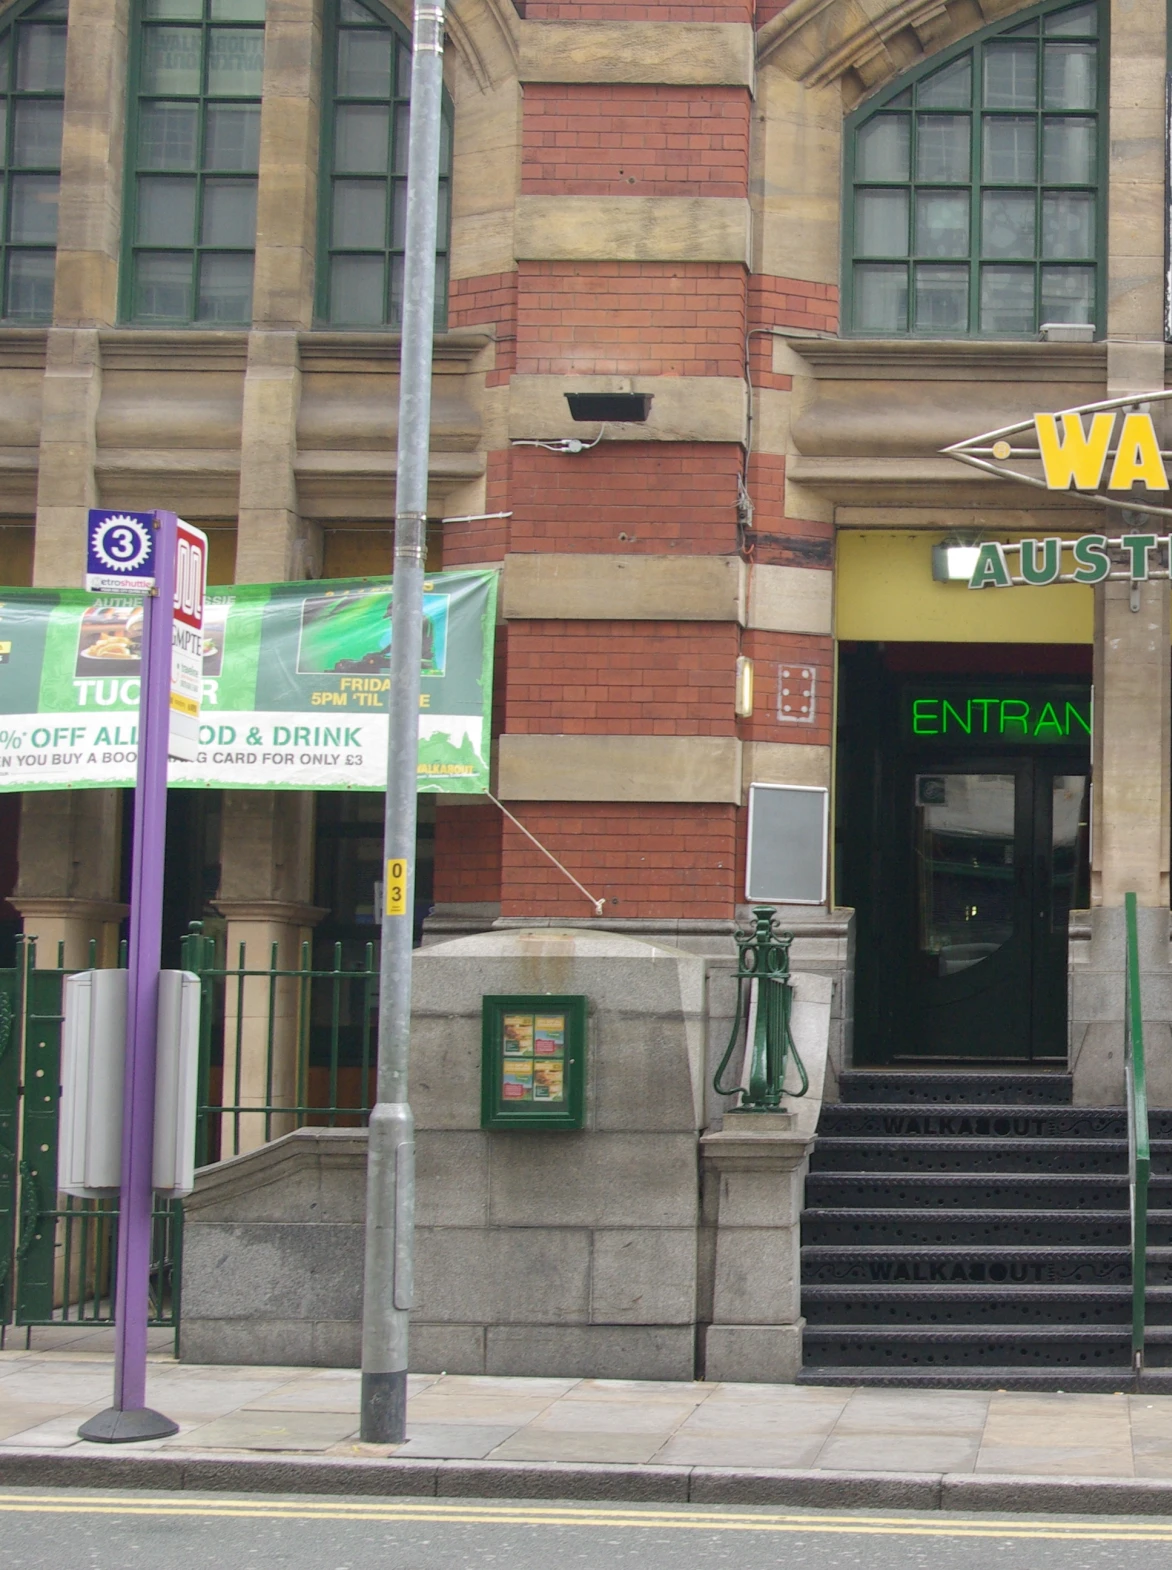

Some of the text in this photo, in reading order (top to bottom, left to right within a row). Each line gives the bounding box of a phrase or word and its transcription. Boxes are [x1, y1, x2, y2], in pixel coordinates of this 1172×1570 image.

[110, 528, 134, 558] 3
[340, 678, 392, 692] FRIDA
[310, 692, 348, 706] 5PM
[31, 726, 87, 748] OFF
[198, 725, 237, 746] OD
[246, 726, 264, 746] &
[273, 726, 362, 748] DRINK
[16, 753, 47, 767] YOU
[51, 752, 83, 766] BUY
[86, 752, 97, 764] A
[212, 752, 257, 765] CARD
[262, 753, 295, 765] FOR
[300, 754, 340, 766] ONLY
[345, 754, 363, 766] £3
[883, 1118, 1047, 1136] WALKABOUT
[868, 1262, 1047, 1282] WALKABOUT
